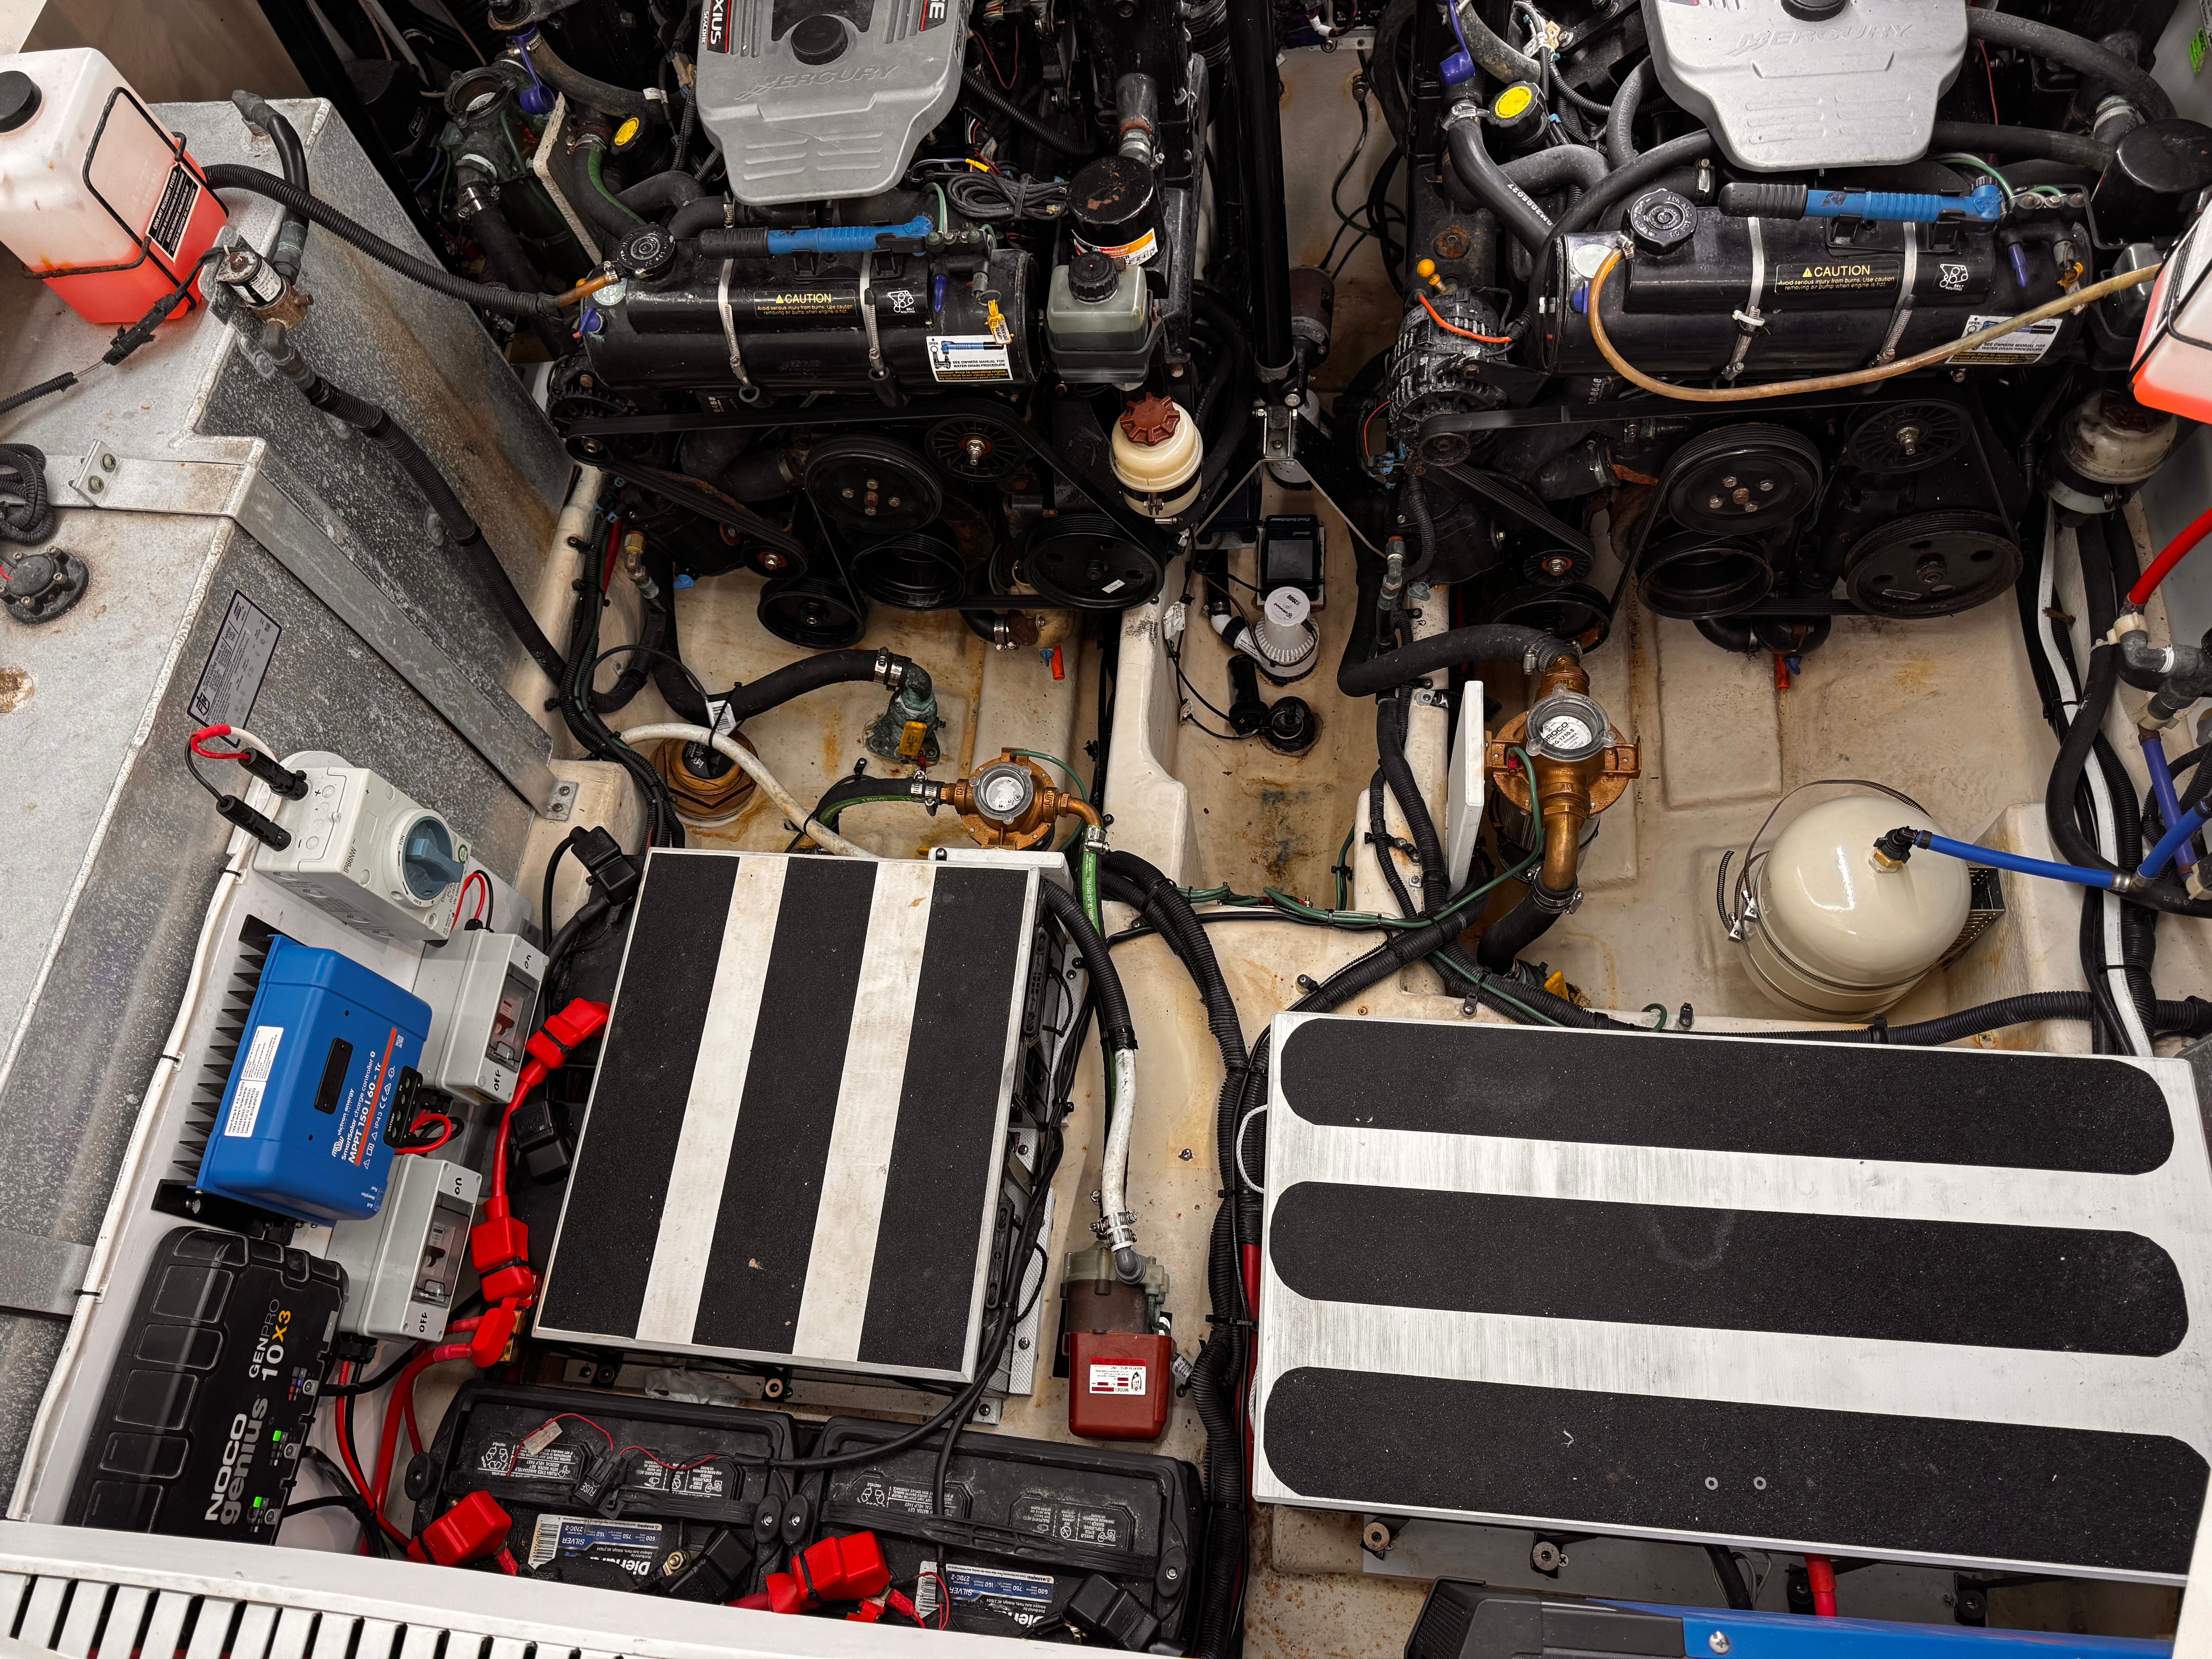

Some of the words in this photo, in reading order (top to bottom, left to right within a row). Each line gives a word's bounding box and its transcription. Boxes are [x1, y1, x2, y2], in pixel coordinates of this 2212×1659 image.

[701, 10, 709, 44] SEACORE
[1738, 23, 1914, 49] MERCURY
[747, 64, 900, 93] MERCURY
[152, 209, 165, 230] COOLANT
[160, 187, 173, 210] RECOVERY
[169, 170, 179, 189] SYSTEM
[1814, 265, 1870, 277] CAUTION
[785, 294, 831, 303] CAUTION
[399, 835, 405, 843] ON
[343, 846, 357, 872] IP66NW
[336, 1112, 347, 1135] victron
[344, 1088, 355, 1112] energy
[341, 1118, 357, 1160] SmartSolar
[353, 1092, 365, 1118] charge
[361, 1058, 374, 1091] controller
[347, 1128, 363, 1163] MPPT
[357, 1106, 369, 1127] 150
[366, 1082, 376, 1098] 60
[374, 1062, 382, 1072] Tr
[374, 1111, 383, 1129] IP43
[419, 1312, 428, 1333] OFF
[249, 1298, 280, 1379] GENPRO
[261, 1310, 291, 1381] 10X3
[204, 1413, 248, 1520] NOCO
[220, 1397, 268, 1525] genius
[580, 1484, 596, 1497] FUSE
